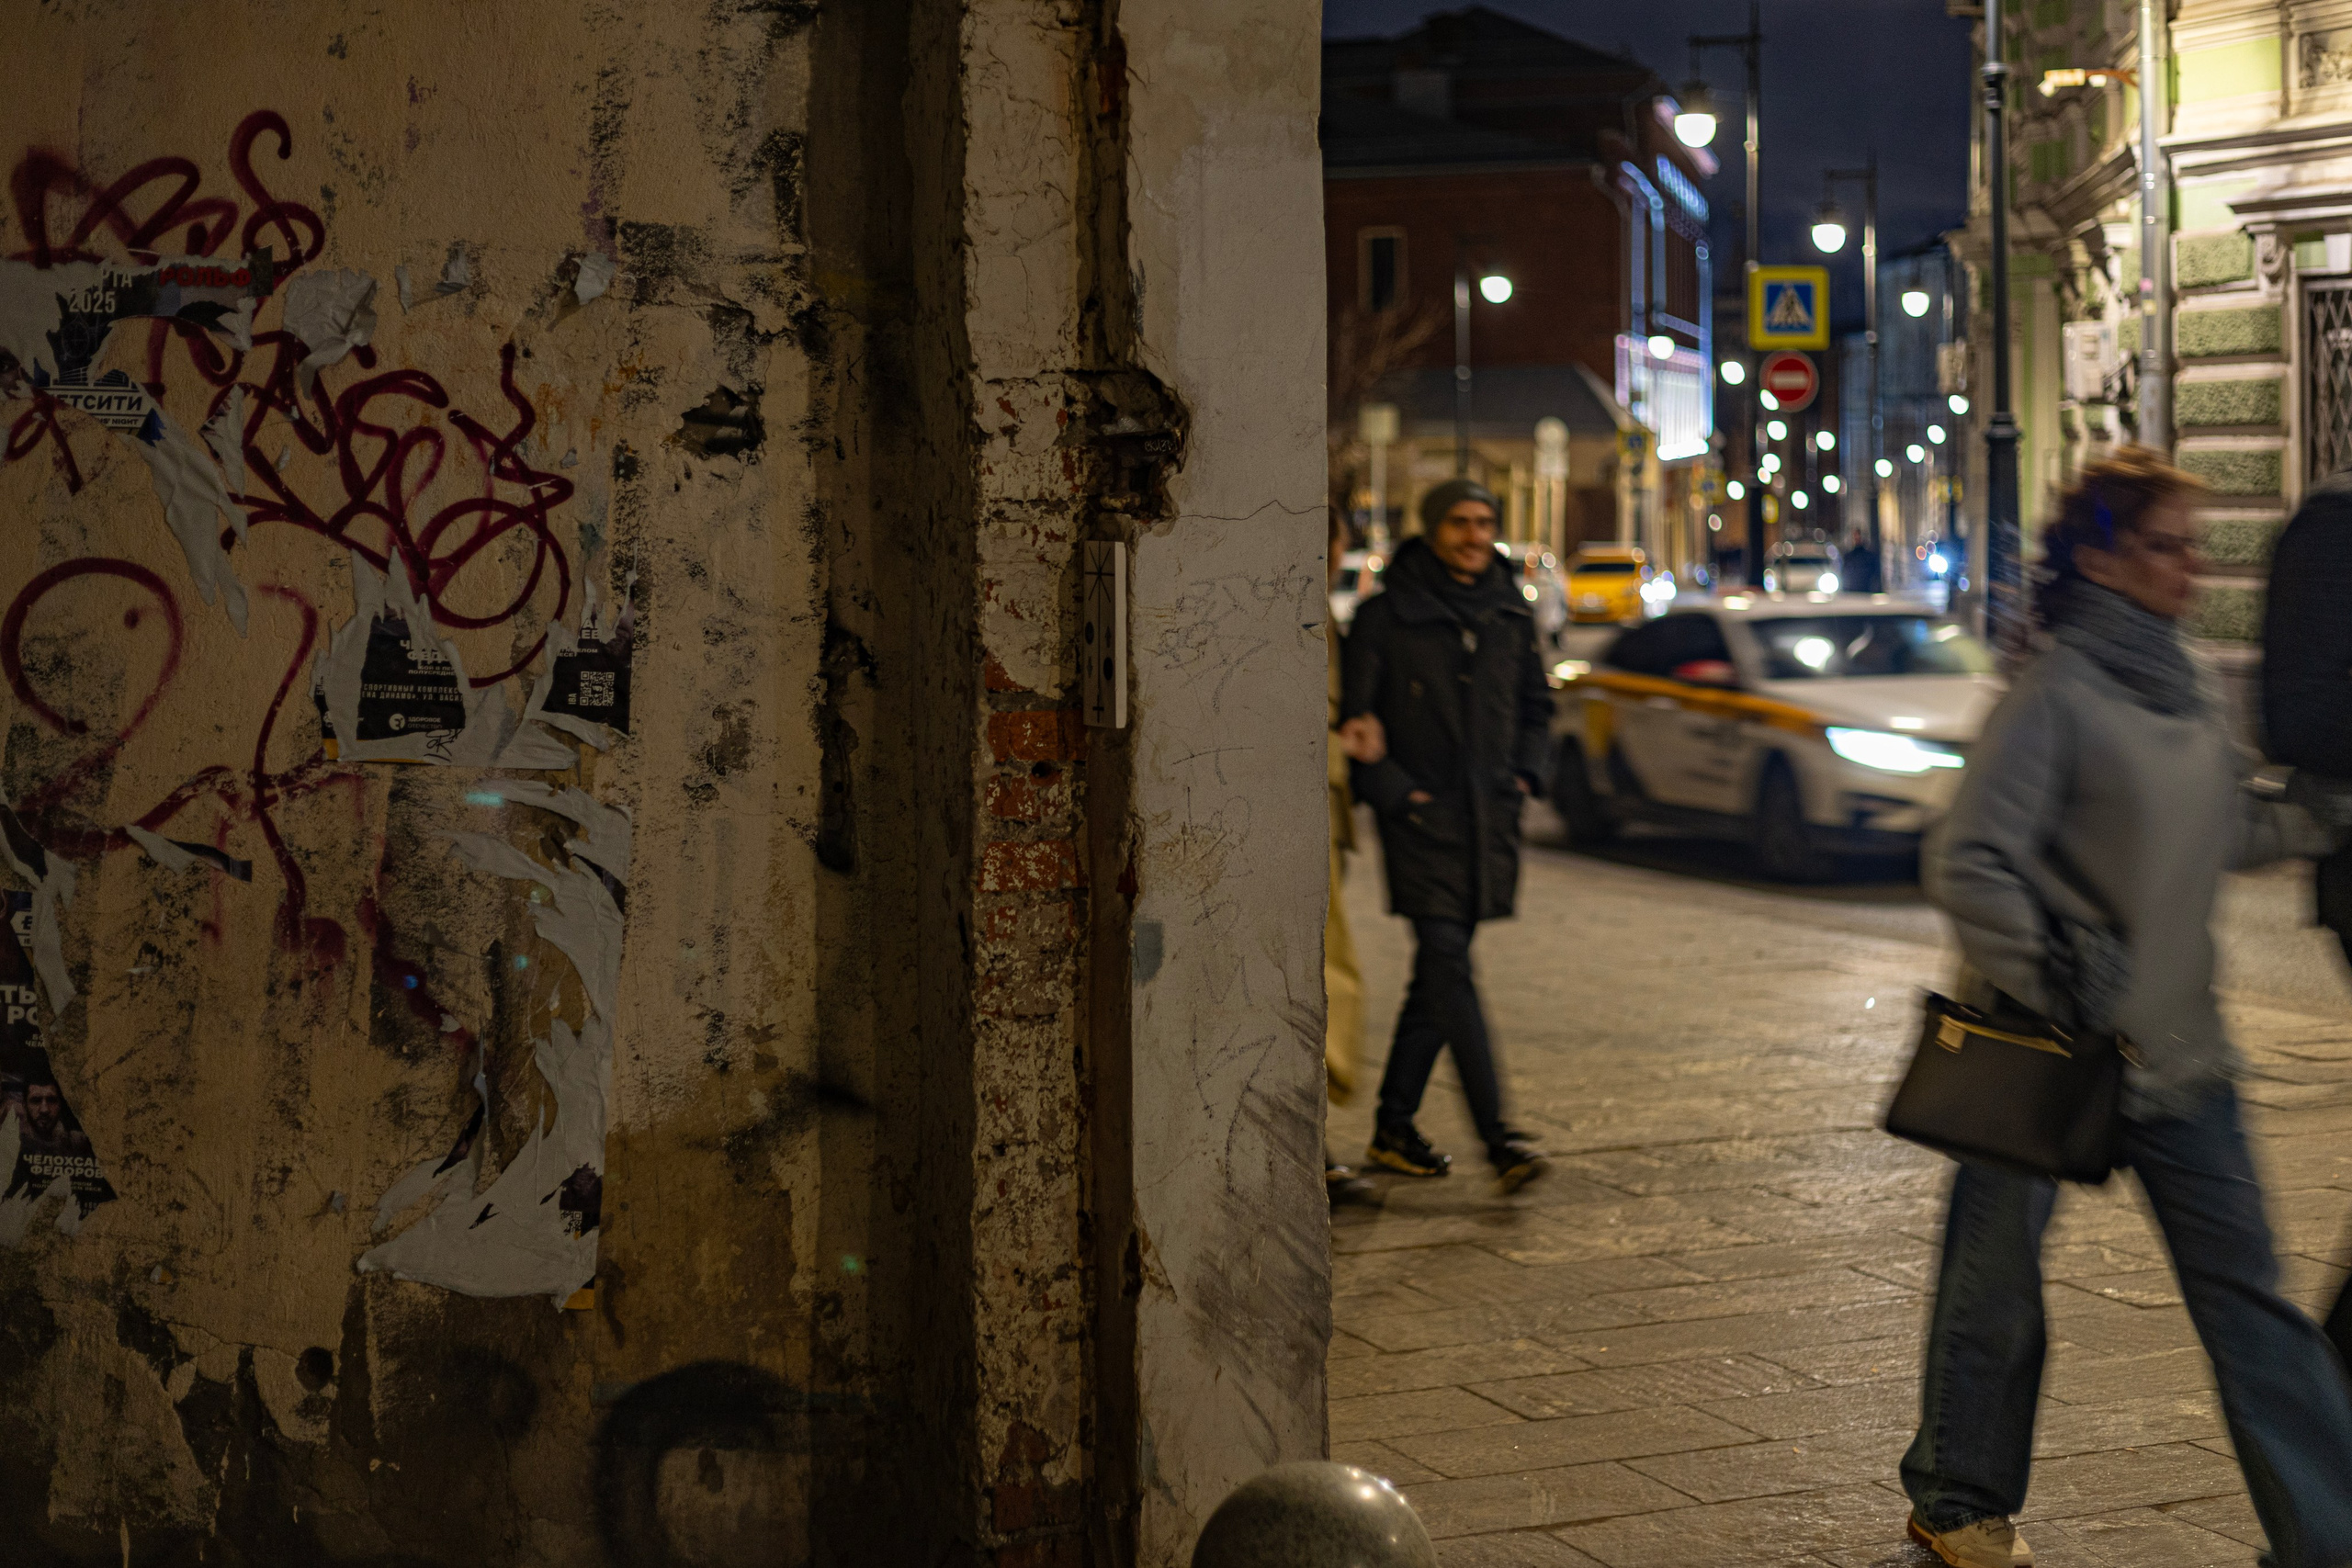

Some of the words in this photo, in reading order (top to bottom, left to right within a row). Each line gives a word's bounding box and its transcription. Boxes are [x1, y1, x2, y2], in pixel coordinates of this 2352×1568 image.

[159, 266, 251, 287] РОЛЬФ
[69, 290, 117, 313] 2025
[56, 394, 143, 411] ЕТСИТИ
[361, 691, 377, 699] ЕНА
[363, 682, 414, 693] СПОРТИВНЫЙ
[417, 685, 459, 694] КОМПЛЕКС
[0, 985, 38, 1005] ТЬ
[30, 1164, 104, 1179] ФЕДОРОВ
